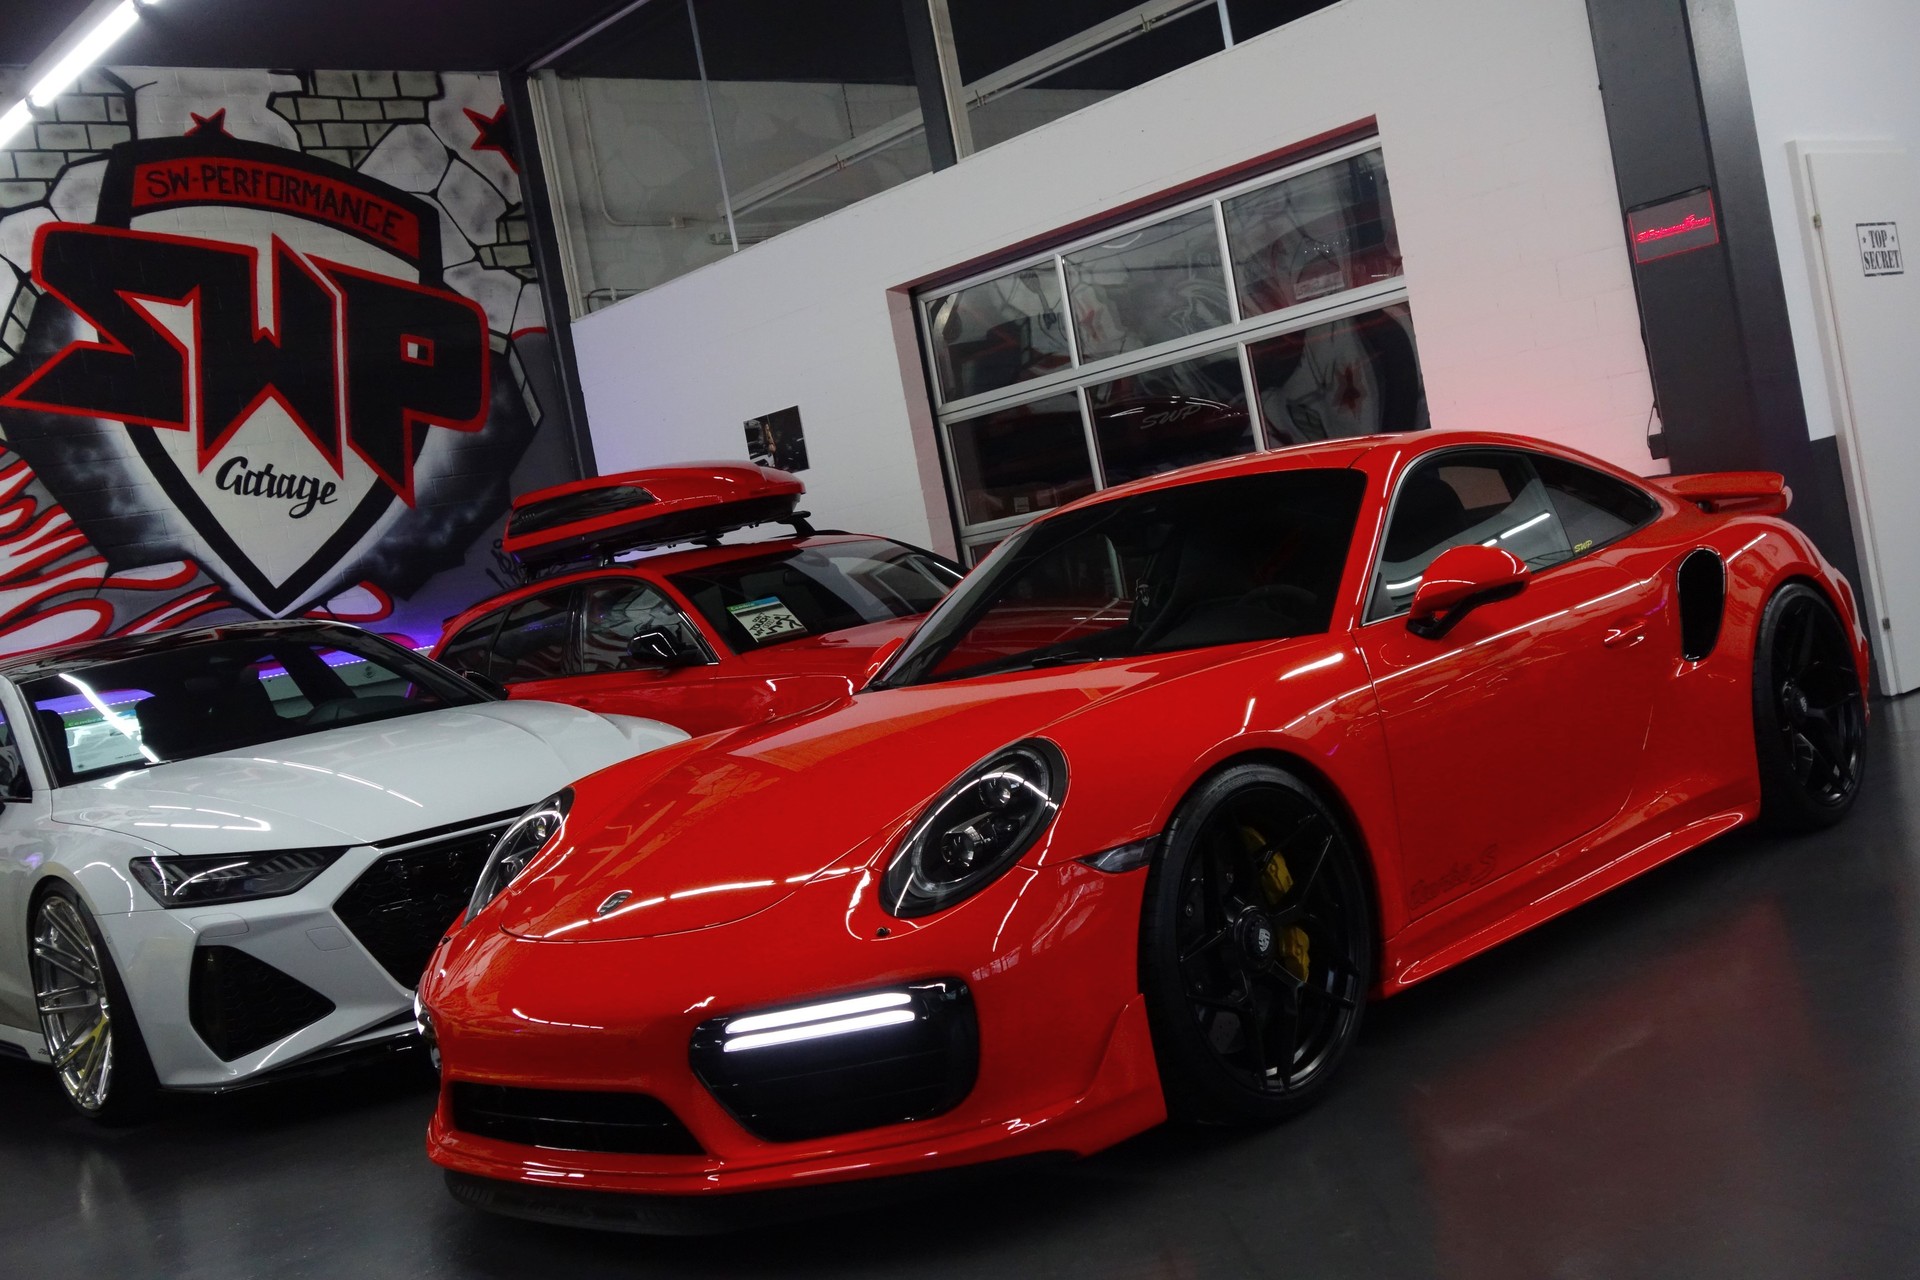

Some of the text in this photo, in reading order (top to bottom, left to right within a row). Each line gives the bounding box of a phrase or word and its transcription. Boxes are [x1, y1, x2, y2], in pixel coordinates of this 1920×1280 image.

[146, 165, 404, 242] SW-PERFORMANCE
[1868, 229, 1888, 249] TOP
[1863, 249, 1900, 270] SECRET
[0, 221, 491, 509] SWP
[1139, 404, 1202, 430] SWP
[215, 456, 338, 519] Garage
[1574, 539, 1593, 553] SWP
[748, 615, 771, 631] TOUCH
